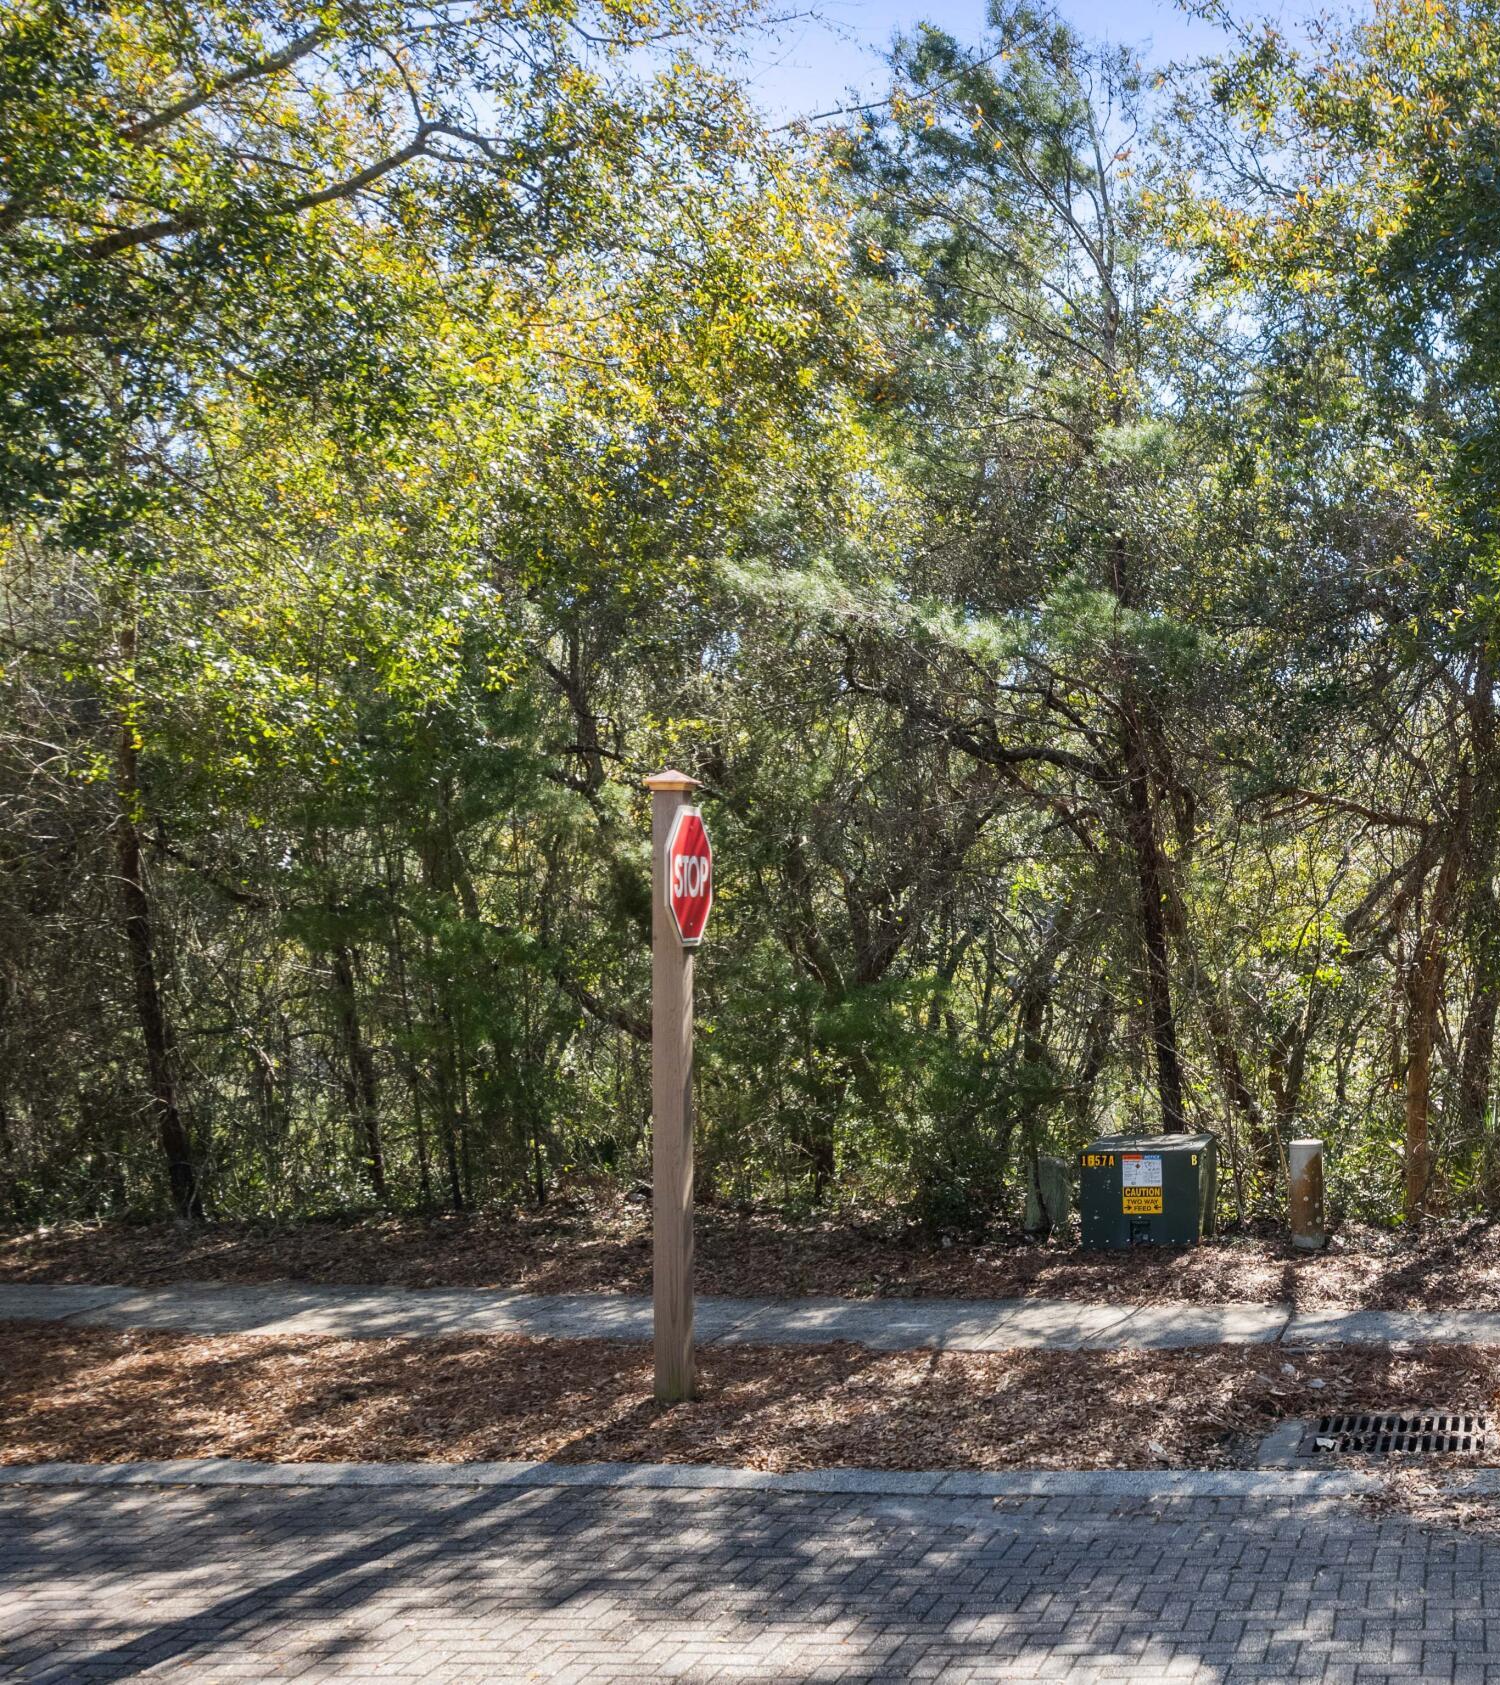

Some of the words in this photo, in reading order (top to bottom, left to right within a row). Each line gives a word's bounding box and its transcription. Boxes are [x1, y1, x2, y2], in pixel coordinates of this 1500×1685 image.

[674, 854, 709, 898] STOP
[1191, 1154, 1198, 1166] B
[1125, 1188, 1161, 1197] CAUTION
